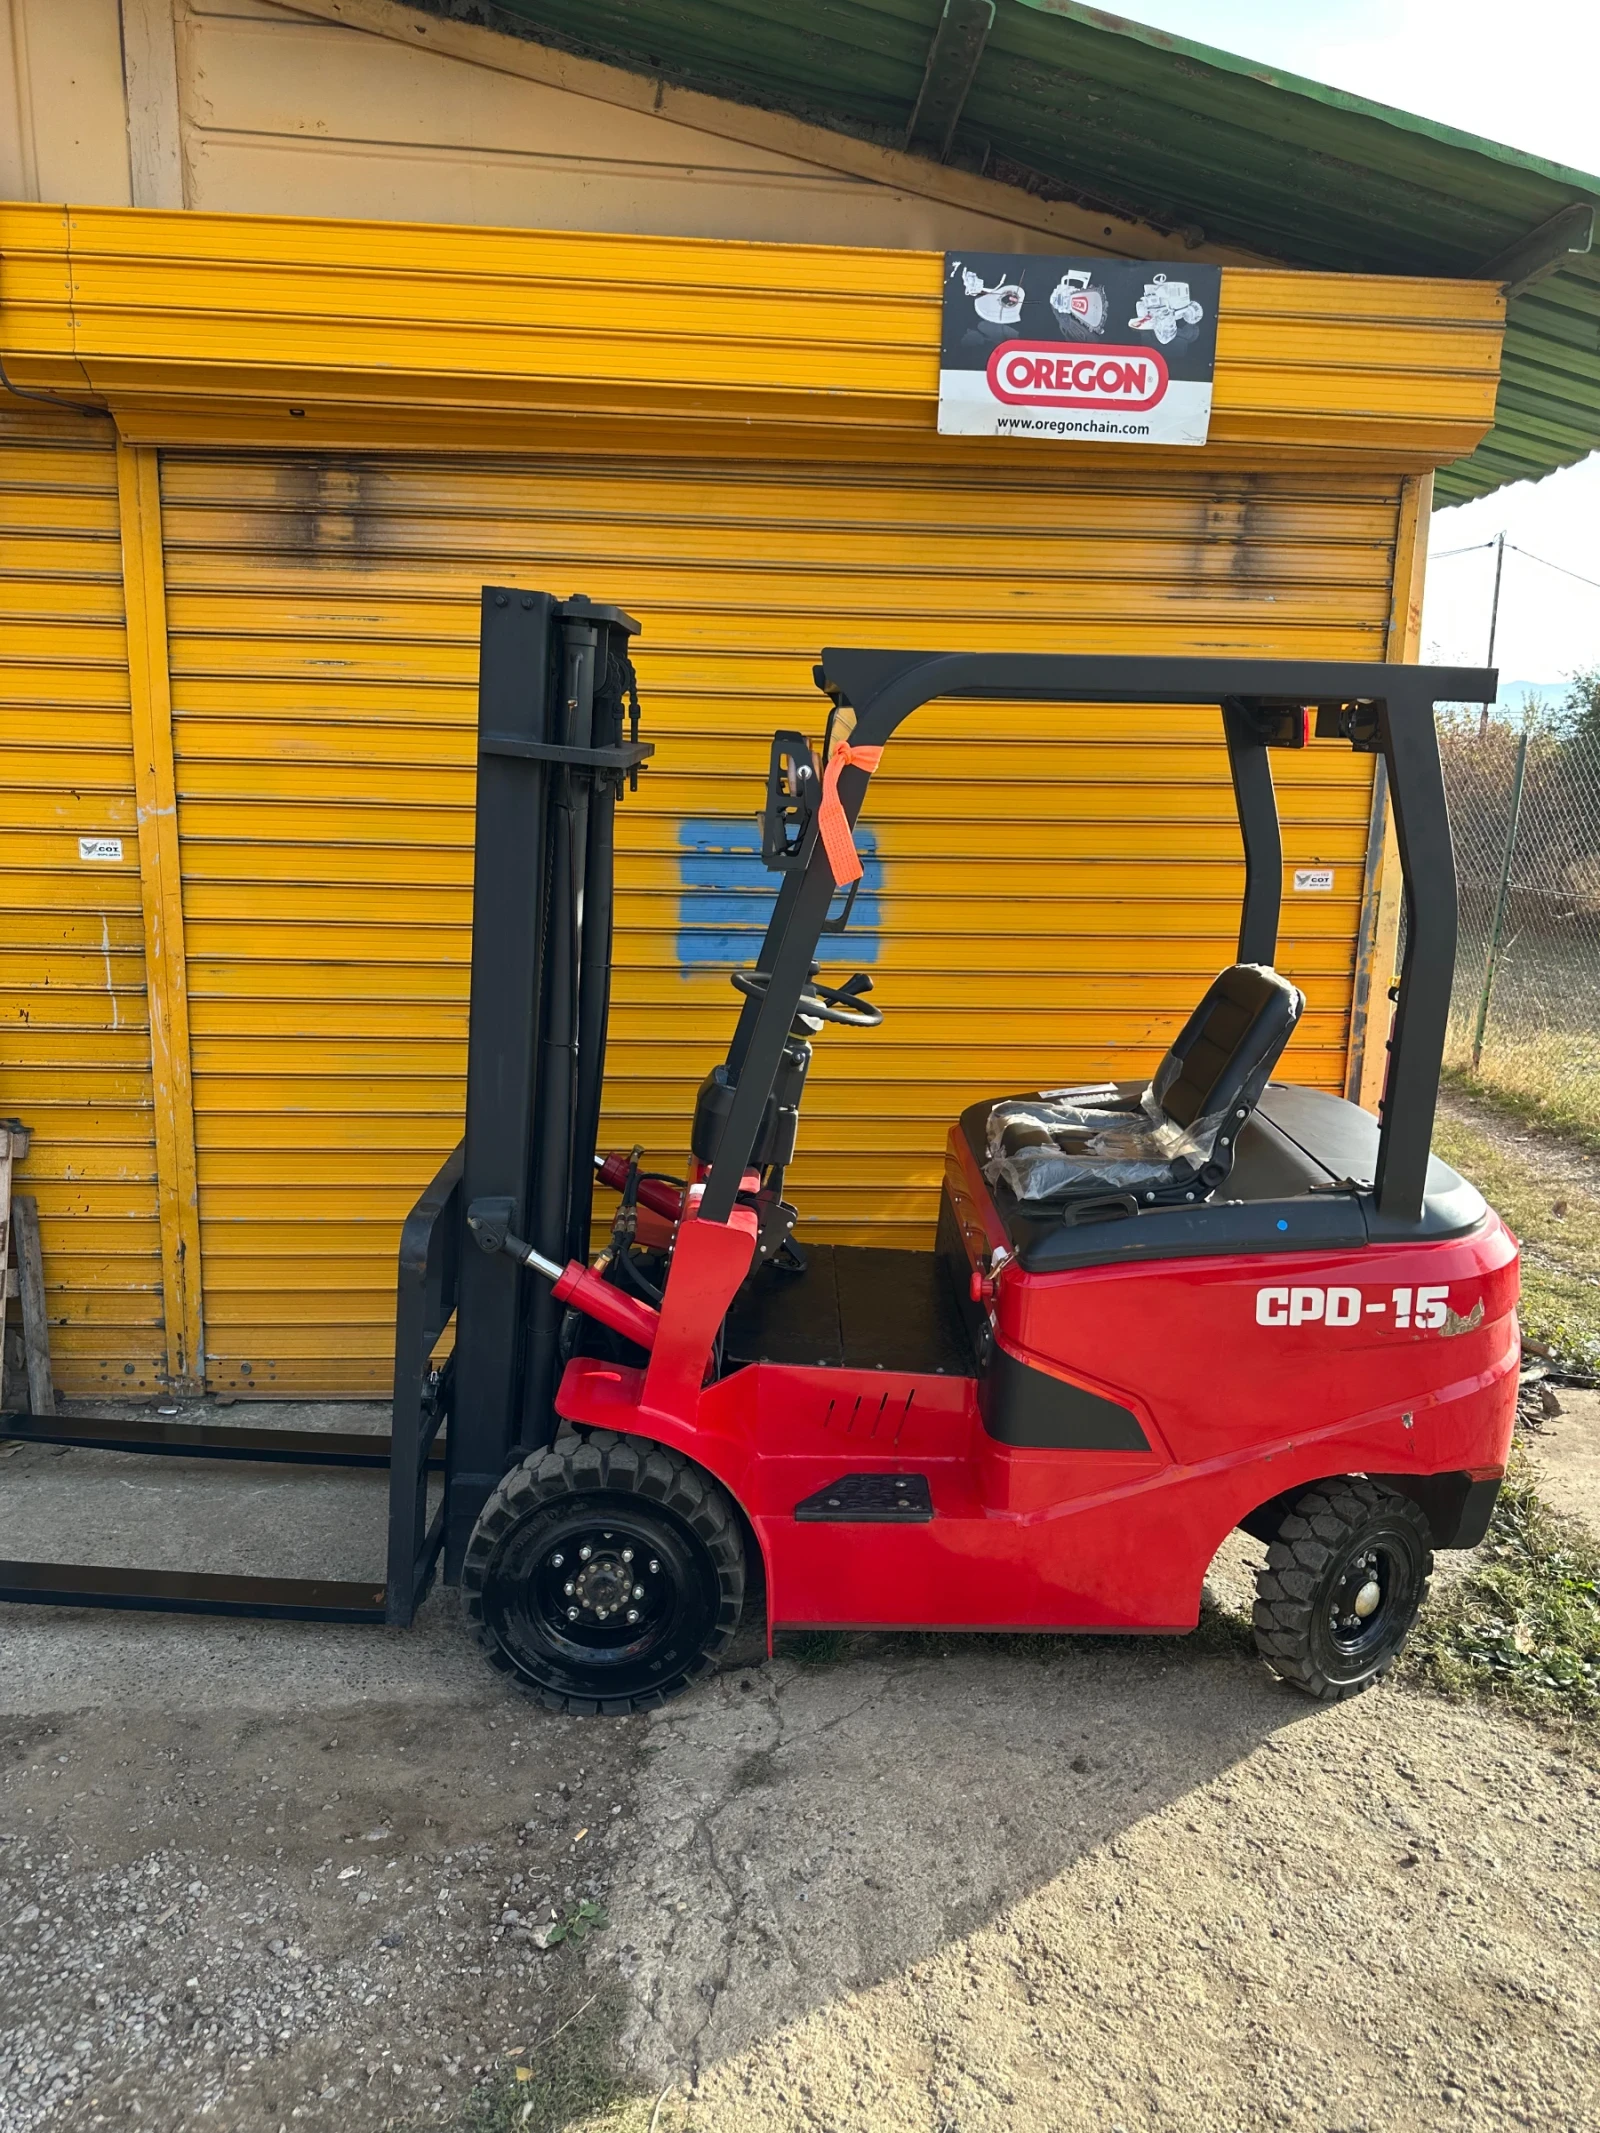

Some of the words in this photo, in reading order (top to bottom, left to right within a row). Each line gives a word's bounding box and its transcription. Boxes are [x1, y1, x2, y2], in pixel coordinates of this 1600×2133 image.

[1006, 357, 1147, 394] OREGON
[997, 416, 1150, 435] www.oregonchain.com
[1256, 1285, 1449, 1329] CPD-15
